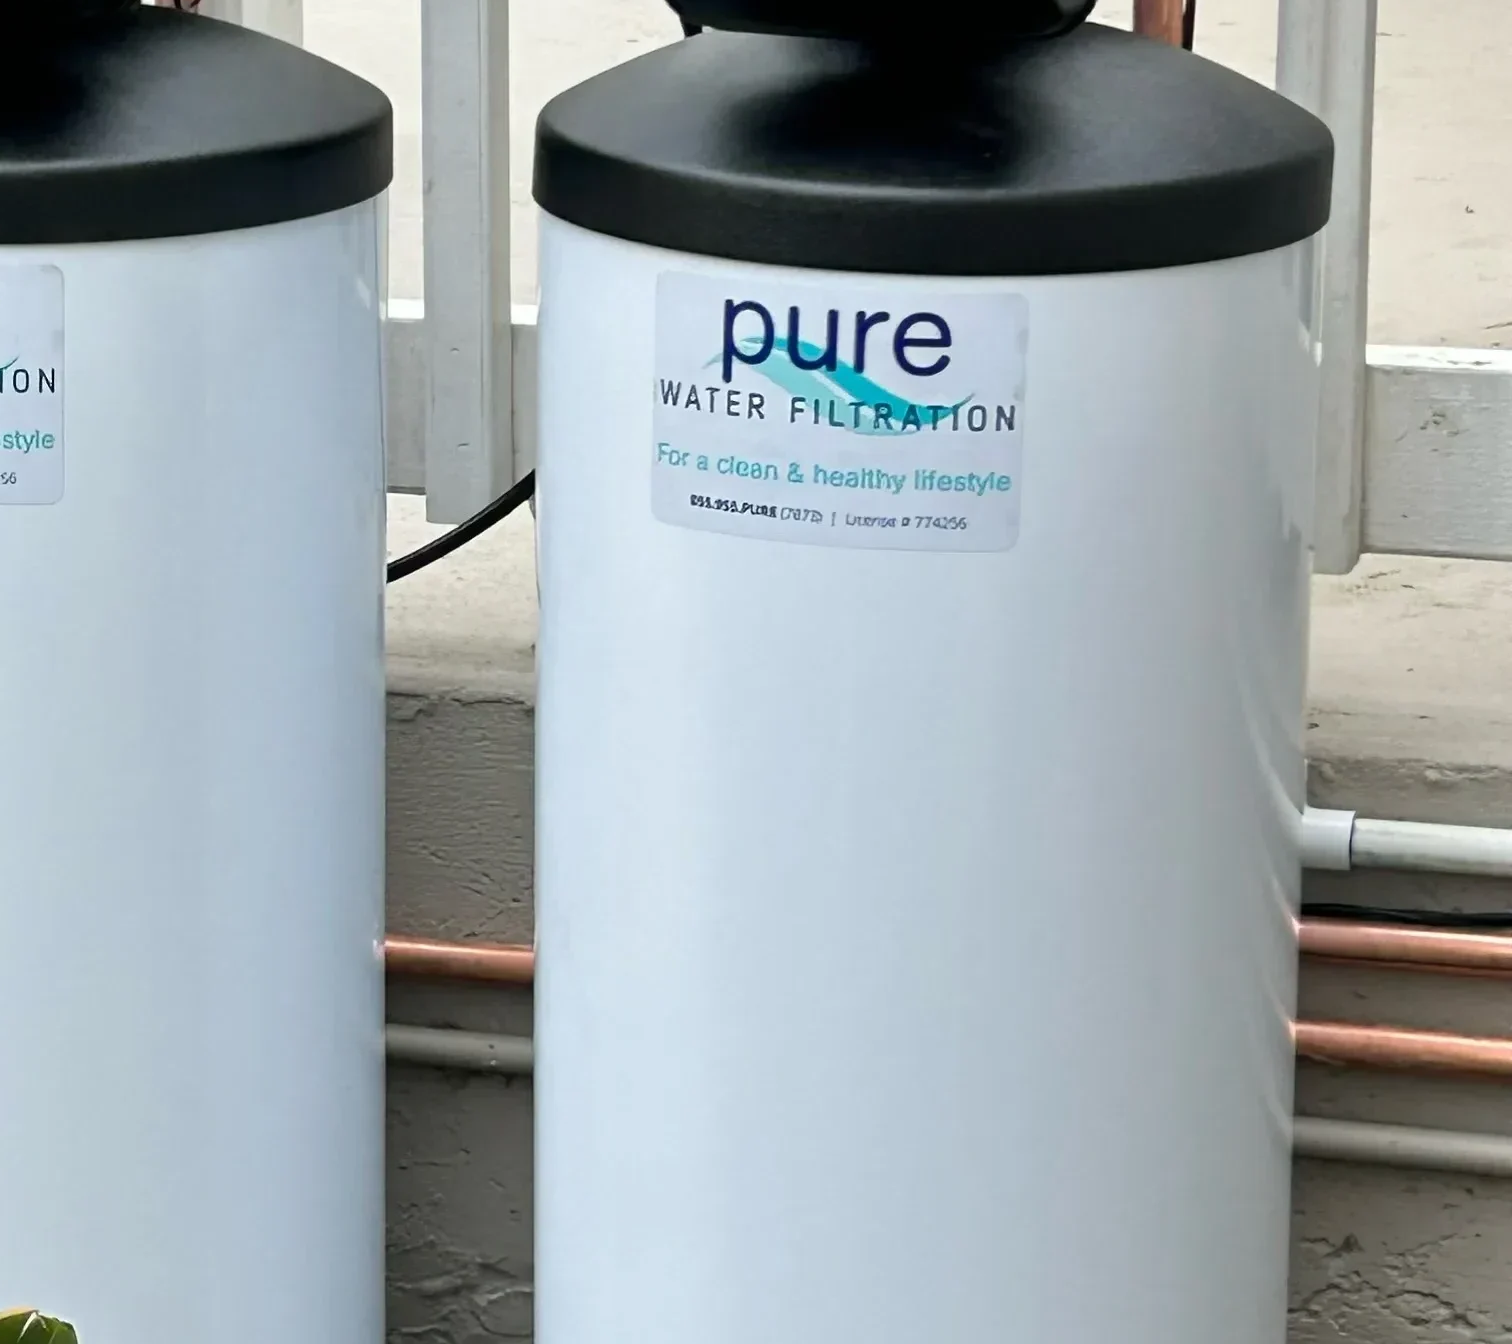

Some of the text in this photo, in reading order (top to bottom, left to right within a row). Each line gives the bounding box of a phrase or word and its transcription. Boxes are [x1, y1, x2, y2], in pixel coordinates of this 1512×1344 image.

[722, 299, 952, 383] pure
[660, 377, 1017, 432] WATER FILTRATION
[657, 442, 1013, 497] For a clean & healthy lifestyle
